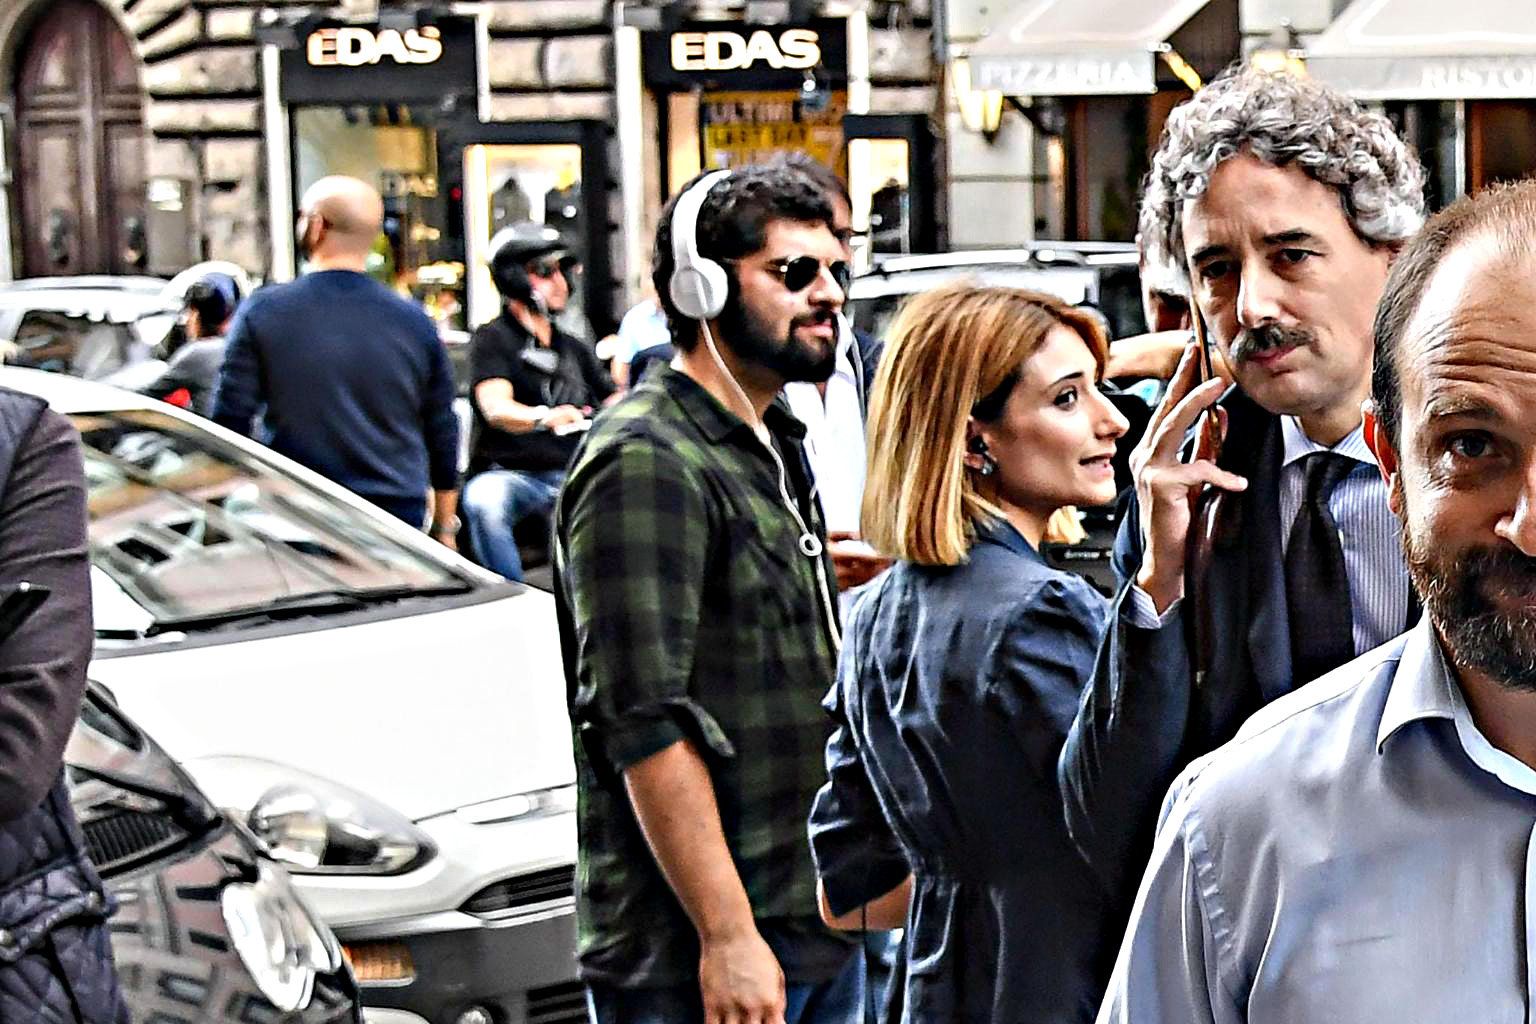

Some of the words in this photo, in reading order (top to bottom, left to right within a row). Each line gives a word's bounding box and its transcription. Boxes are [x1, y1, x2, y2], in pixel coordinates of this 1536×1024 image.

[307, 26, 443, 66] EDAS
[671, 29, 821, 70] EDAS
[980, 61, 1137, 87] PIZZERIA
